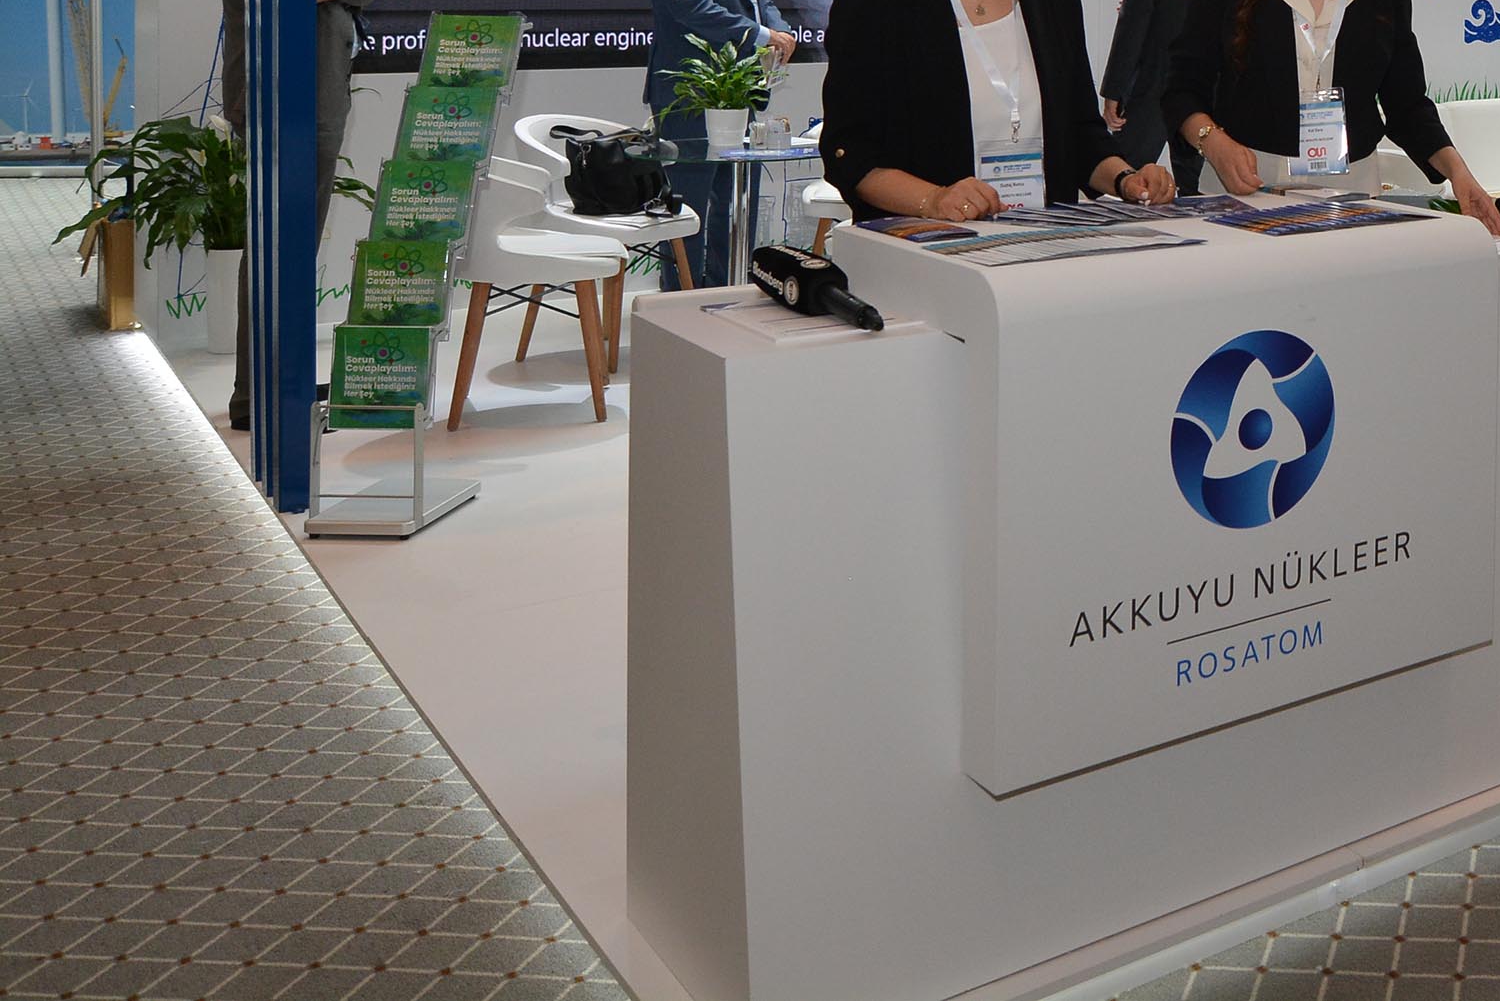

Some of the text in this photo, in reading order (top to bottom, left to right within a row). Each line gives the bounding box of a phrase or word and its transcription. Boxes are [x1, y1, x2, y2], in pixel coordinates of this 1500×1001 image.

[382, 29, 427, 55] prof
[520, 28, 590, 48] nuclear
[594, 27, 654, 51] engine
[1069, 531, 1412, 648] AKKUYU NÜKLEER
[1176, 621, 1324, 686] ROSATOM
